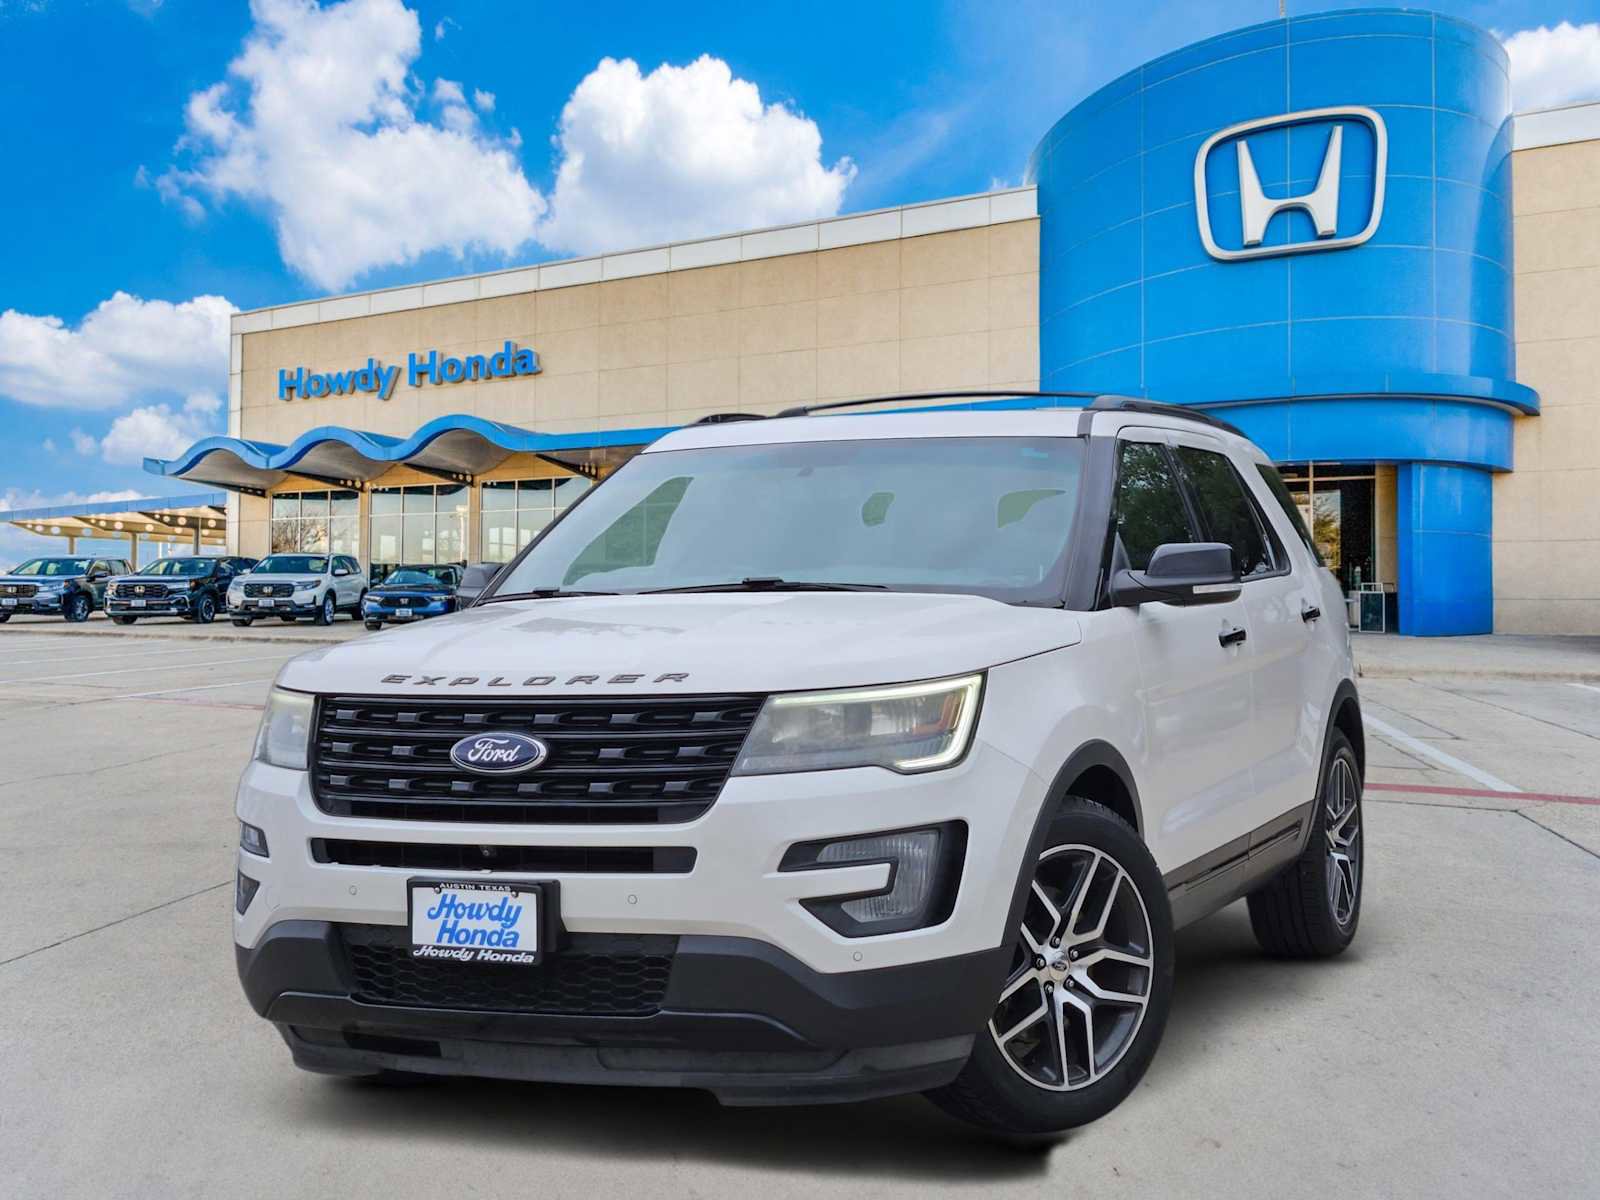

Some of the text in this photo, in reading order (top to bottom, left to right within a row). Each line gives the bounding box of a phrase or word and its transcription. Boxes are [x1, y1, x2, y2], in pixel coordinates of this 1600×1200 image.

[278, 340, 541, 400] Howdy Honda
[380, 672, 690, 687] EXPLORER
[467, 737, 521, 763] Ford
[439, 882, 512, 892] AUSTIN TEXAS
[427, 893, 523, 929] Howdy
[436, 919, 520, 948] Honda
[413, 945, 535, 963] Howdy Honda
